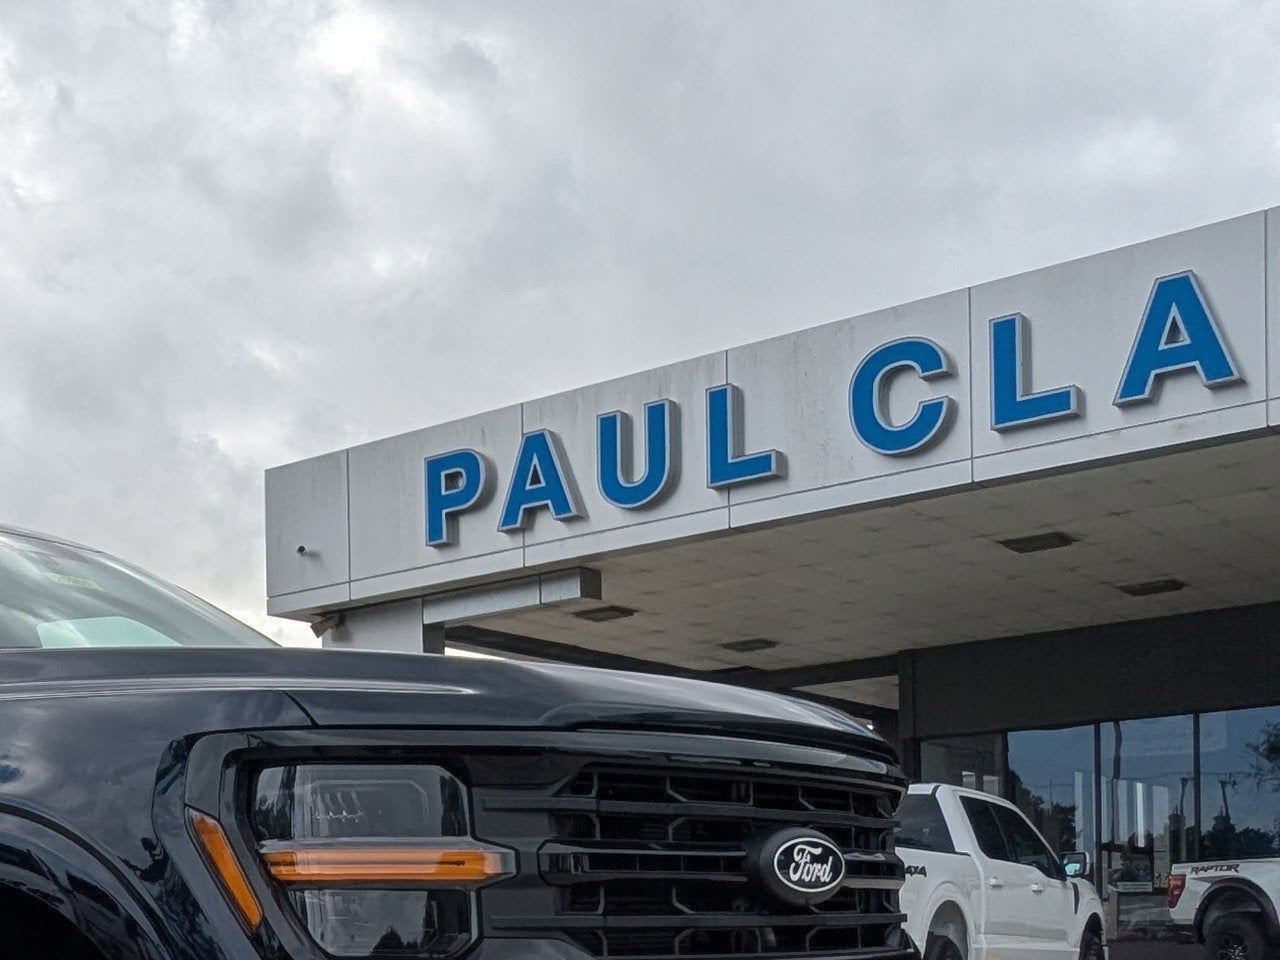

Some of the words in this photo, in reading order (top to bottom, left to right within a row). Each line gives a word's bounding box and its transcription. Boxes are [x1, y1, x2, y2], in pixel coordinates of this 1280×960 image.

[424, 383, 785, 548] PAUL
[849, 270, 1244, 456] CLA
[789, 844, 833, 882] Ford
[1188, 863, 1240, 875] RAPTOR
